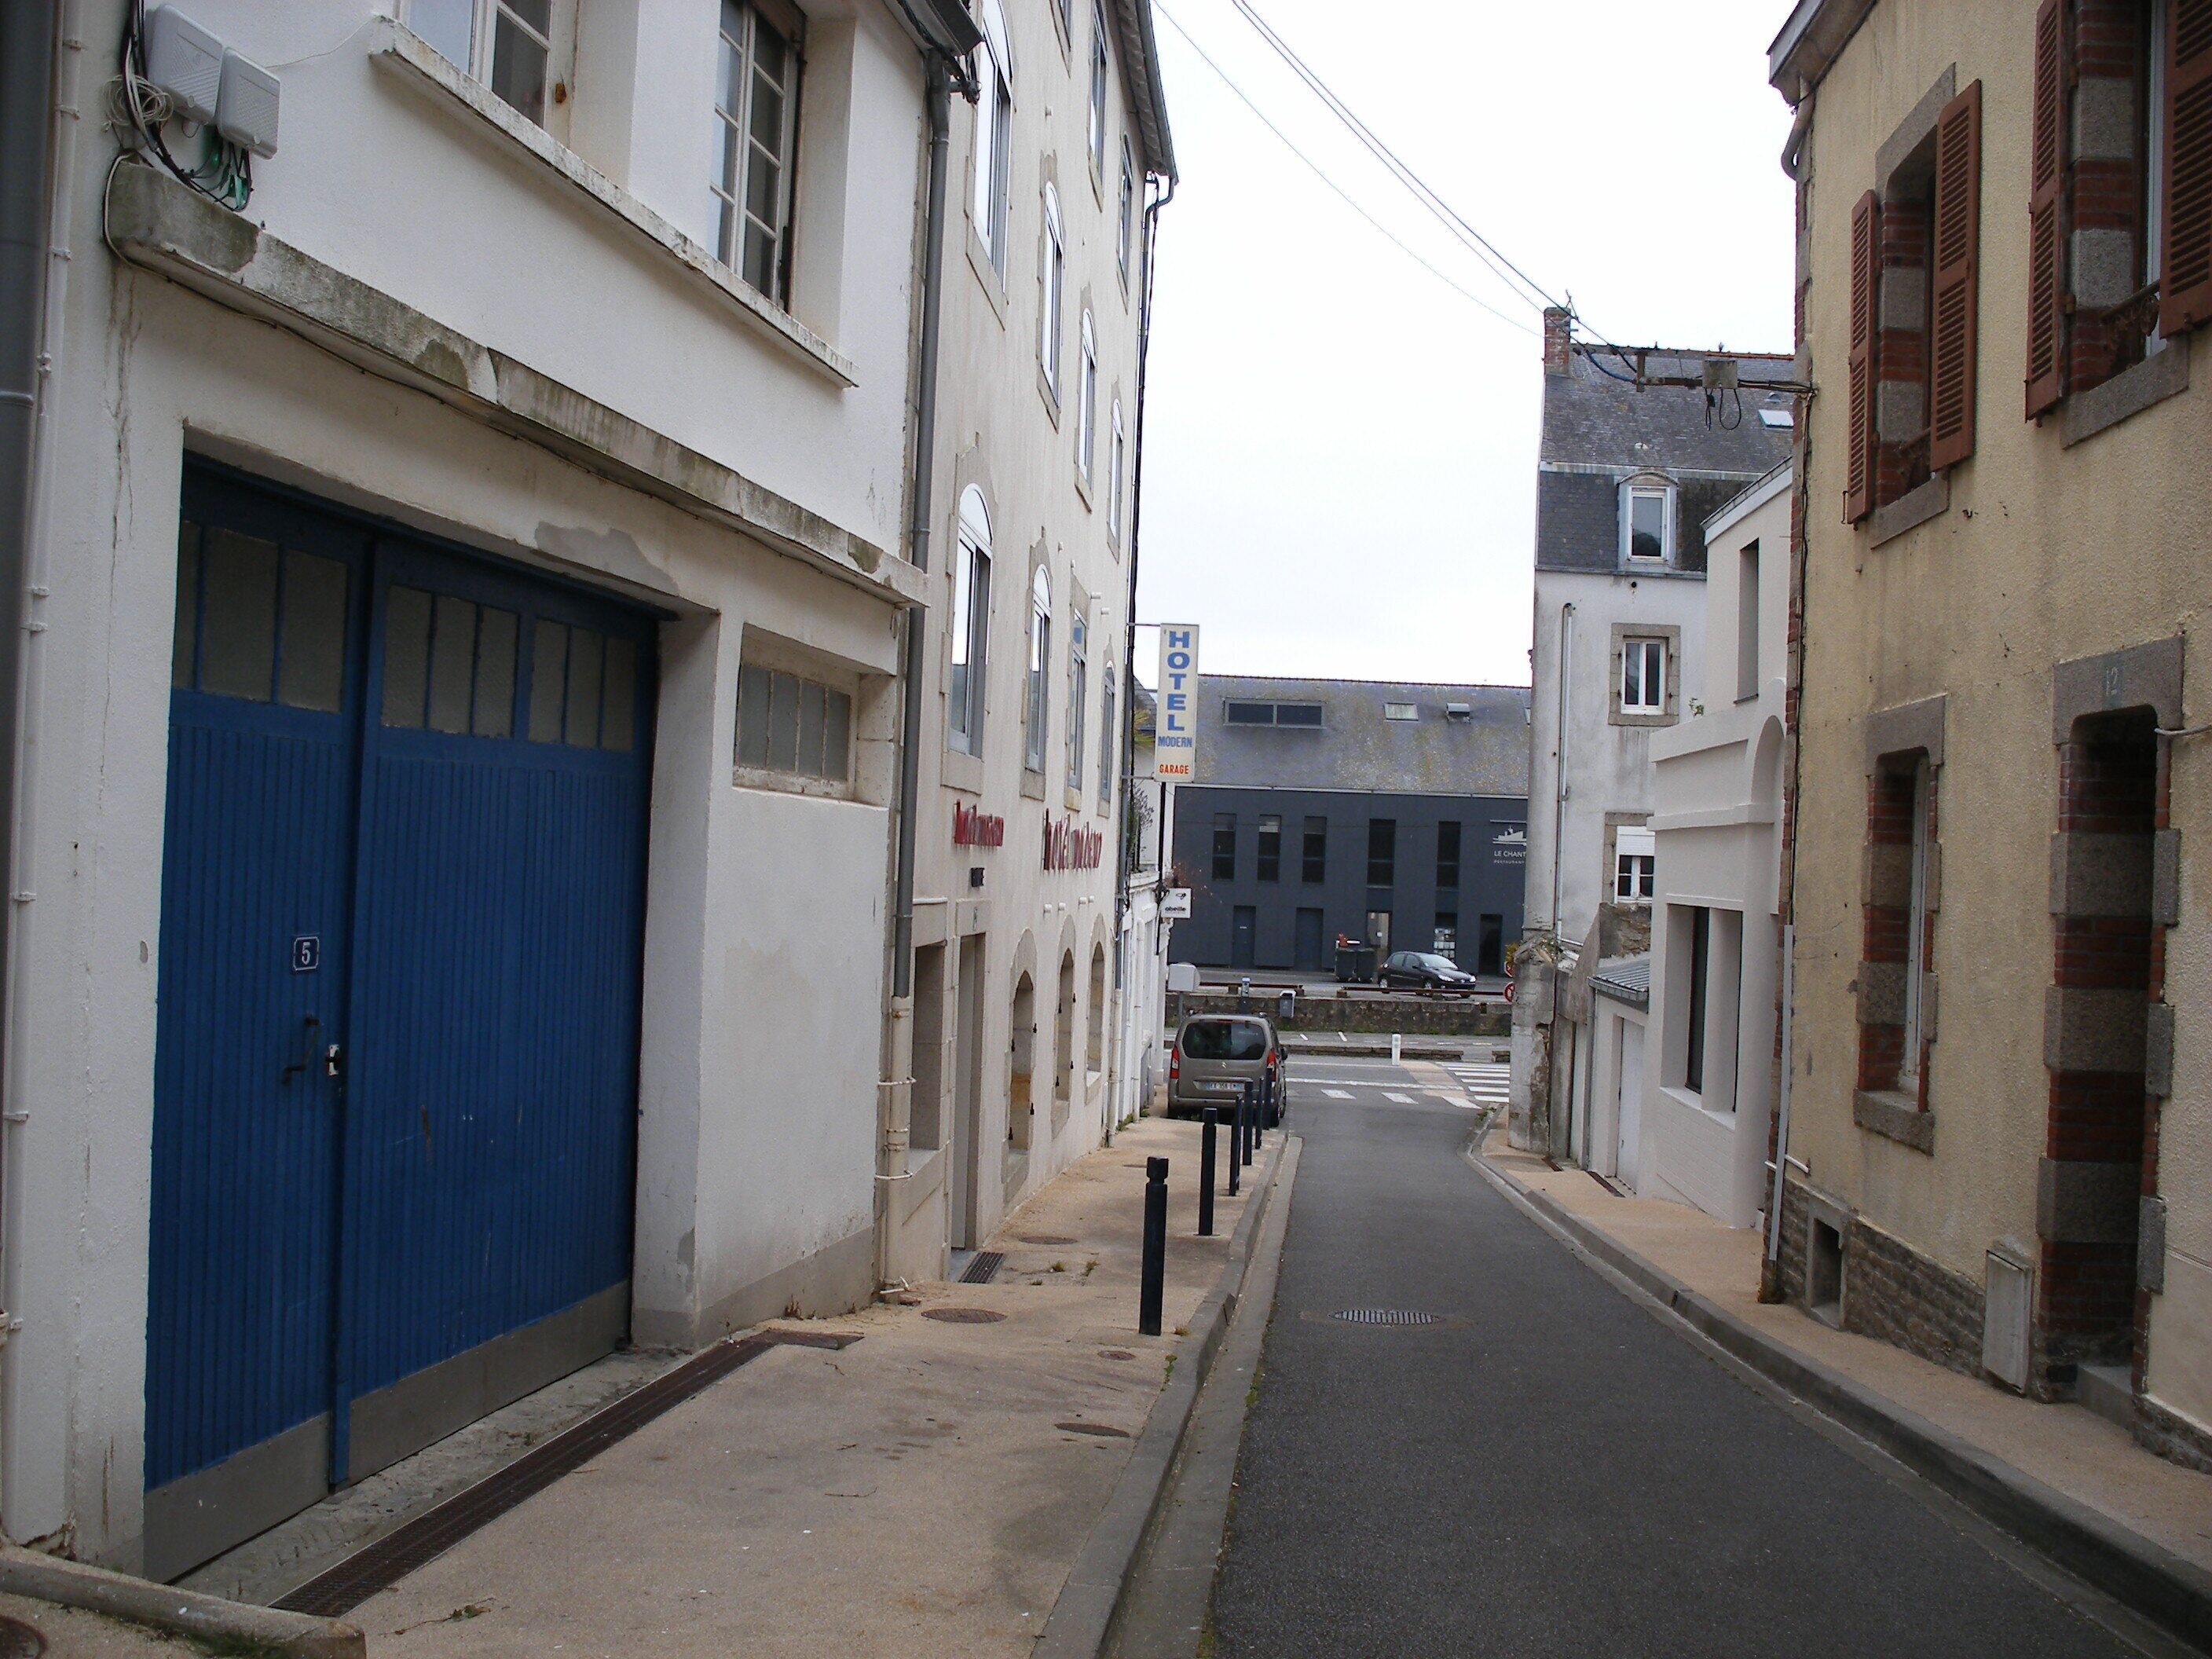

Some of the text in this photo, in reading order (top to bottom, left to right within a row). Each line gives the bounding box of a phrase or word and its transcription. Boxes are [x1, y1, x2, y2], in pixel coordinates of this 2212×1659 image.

[1166, 630, 1190, 731] HOTEL
[2105, 665, 2119, 697] 12
[1157, 735, 1192, 748] MODERN
[1159, 764, 1189, 775] GARAGE
[301, 933, 311, 965] 5
